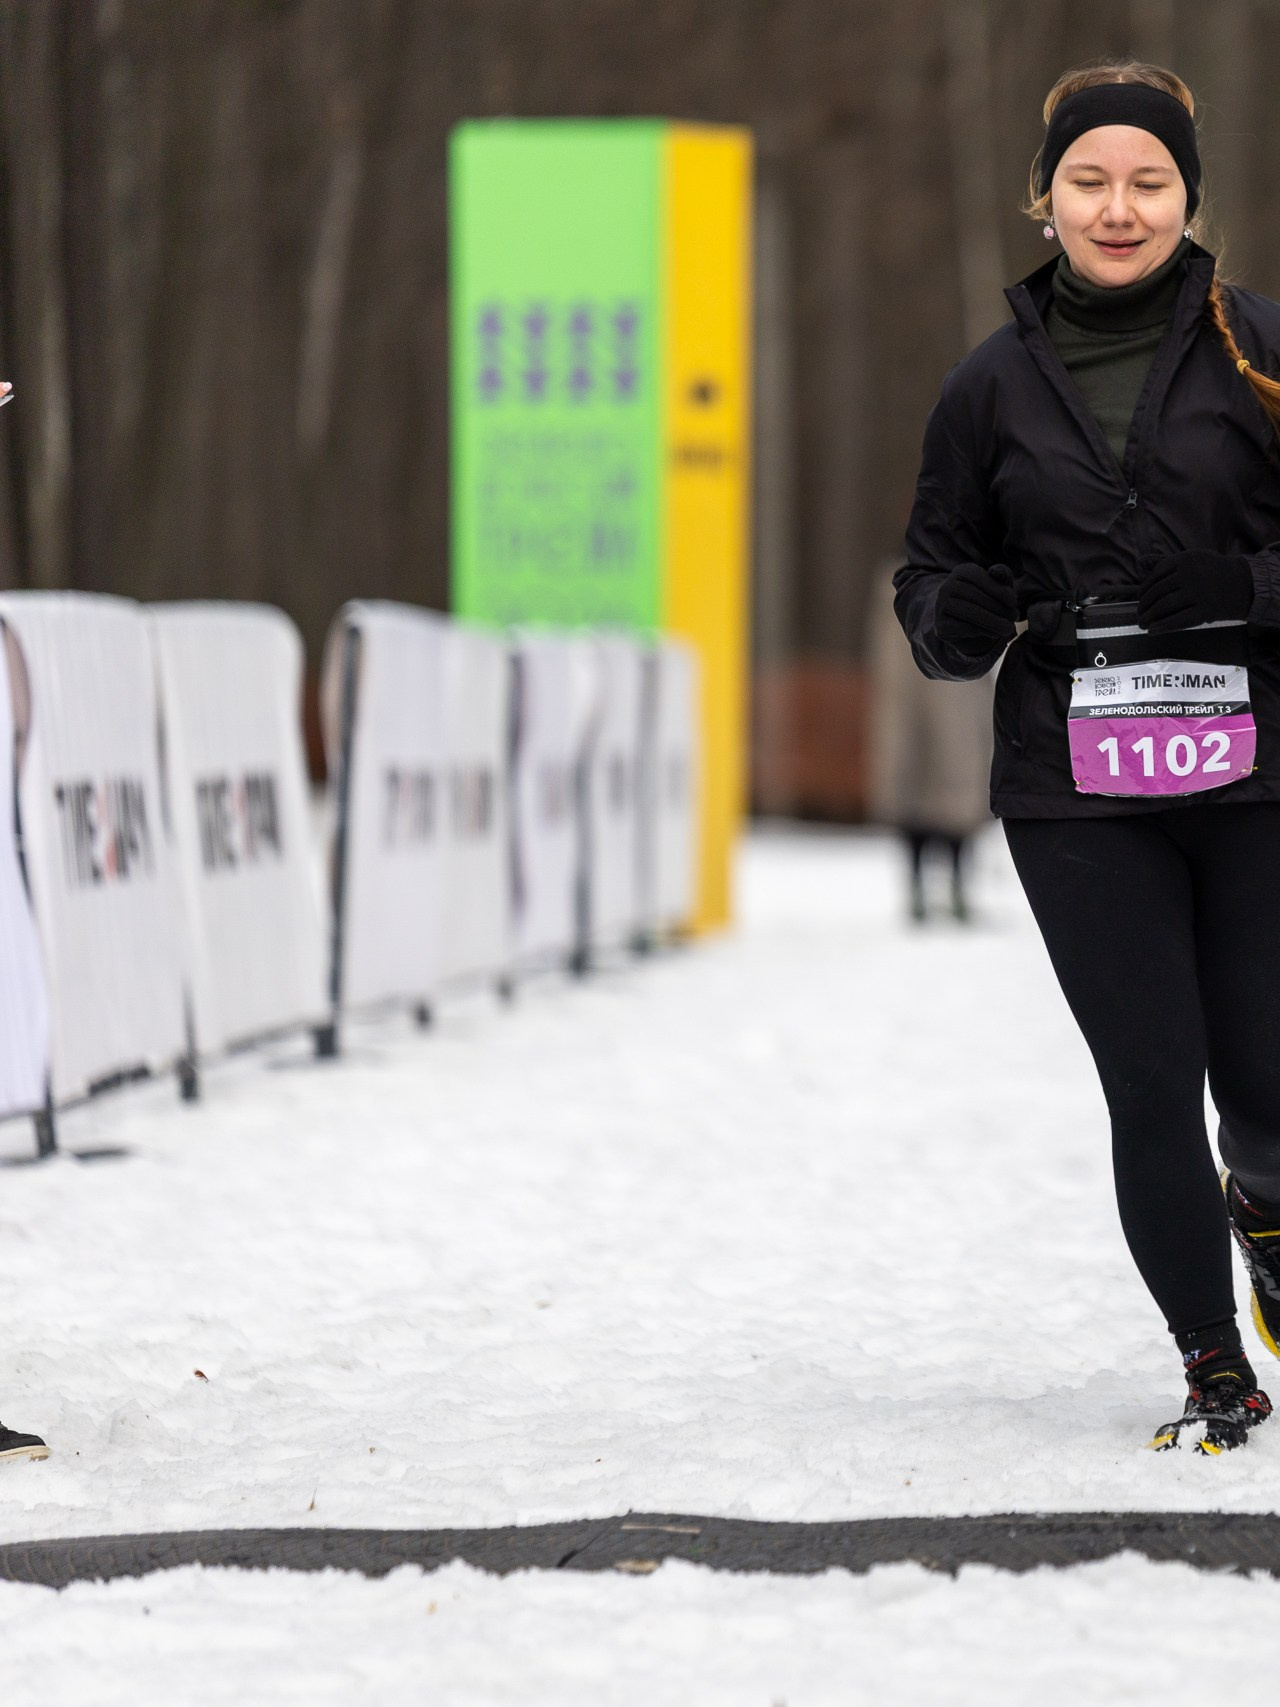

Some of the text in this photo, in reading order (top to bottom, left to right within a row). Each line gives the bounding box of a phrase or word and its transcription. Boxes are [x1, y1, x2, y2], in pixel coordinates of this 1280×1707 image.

[1089, 704, 1183, 716] ЗЕЛЕНОДОЛЬСКИЙ
[1183, 704, 1215, 715] ТРЕЙЛ
[1097, 731, 1231, 777] 1102
